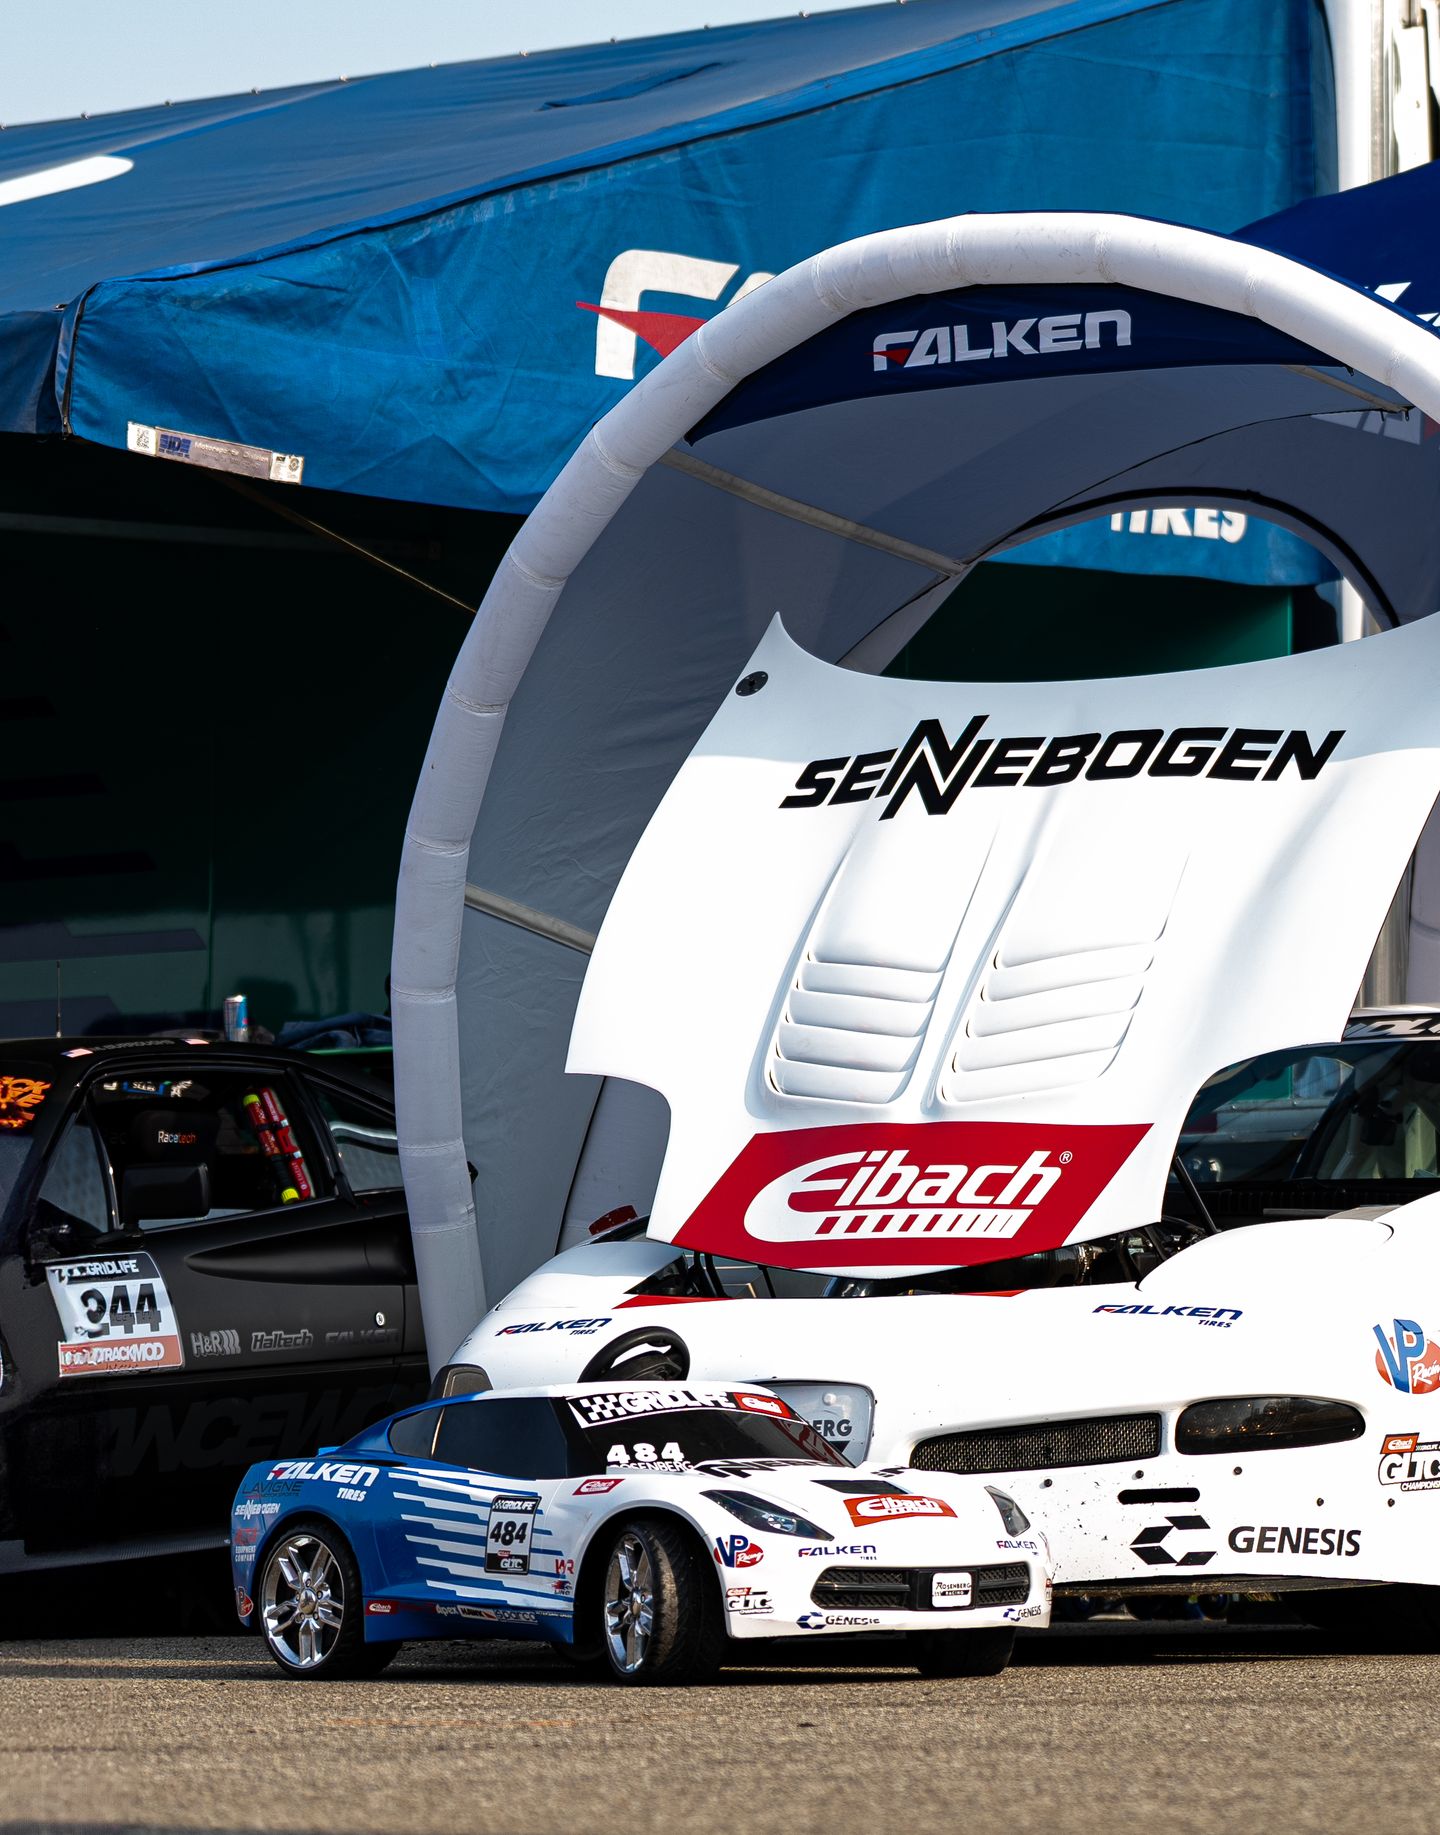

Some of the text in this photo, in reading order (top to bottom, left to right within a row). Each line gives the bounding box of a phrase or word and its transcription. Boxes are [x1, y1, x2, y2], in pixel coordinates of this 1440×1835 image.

[866, 309, 1132, 371] FALKEN
[157, 1130, 197, 1144] Racetech
[743, 1149, 1063, 1234] Eibach
[85, 1259, 140, 1275] GRIDLIFE
[1092, 1304, 1244, 1321] FALKEN
[495, 1318, 613, 1337] FALKEN
[569, 1328, 599, 1336] TIRES
[1197, 1319, 1233, 1329] TIRES
[191, 1332, 224, 1356] H&R
[252, 1329, 314, 1352] Haltech
[1372, 1318, 1426, 1393] VP
[619, 1389, 736, 1411] GRIDLIFE
[606, 1442, 685, 1464] 484
[267, 1462, 380, 1487] FALKEN
[242, 1481, 304, 1495] LAVIGNE
[336, 1487, 367, 1502] TIRES
[502, 1499, 536, 1510] GRIDLIFE
[855, 1497, 944, 1517] Eibach
[489, 1520, 529, 1546] 484
[1228, 1525, 1362, 1557] GENESIS
[715, 1534, 749, 1568] VP
[798, 1544, 877, 1559] FALKEN
[996, 1540, 1038, 1549] FALKEN
[736, 1550, 764, 1565] Racing
[936, 1581, 972, 1590] ROSENBERG
[436, 1603, 458, 1616] Apex
[1017, 1604, 1042, 1618] GENESIS
